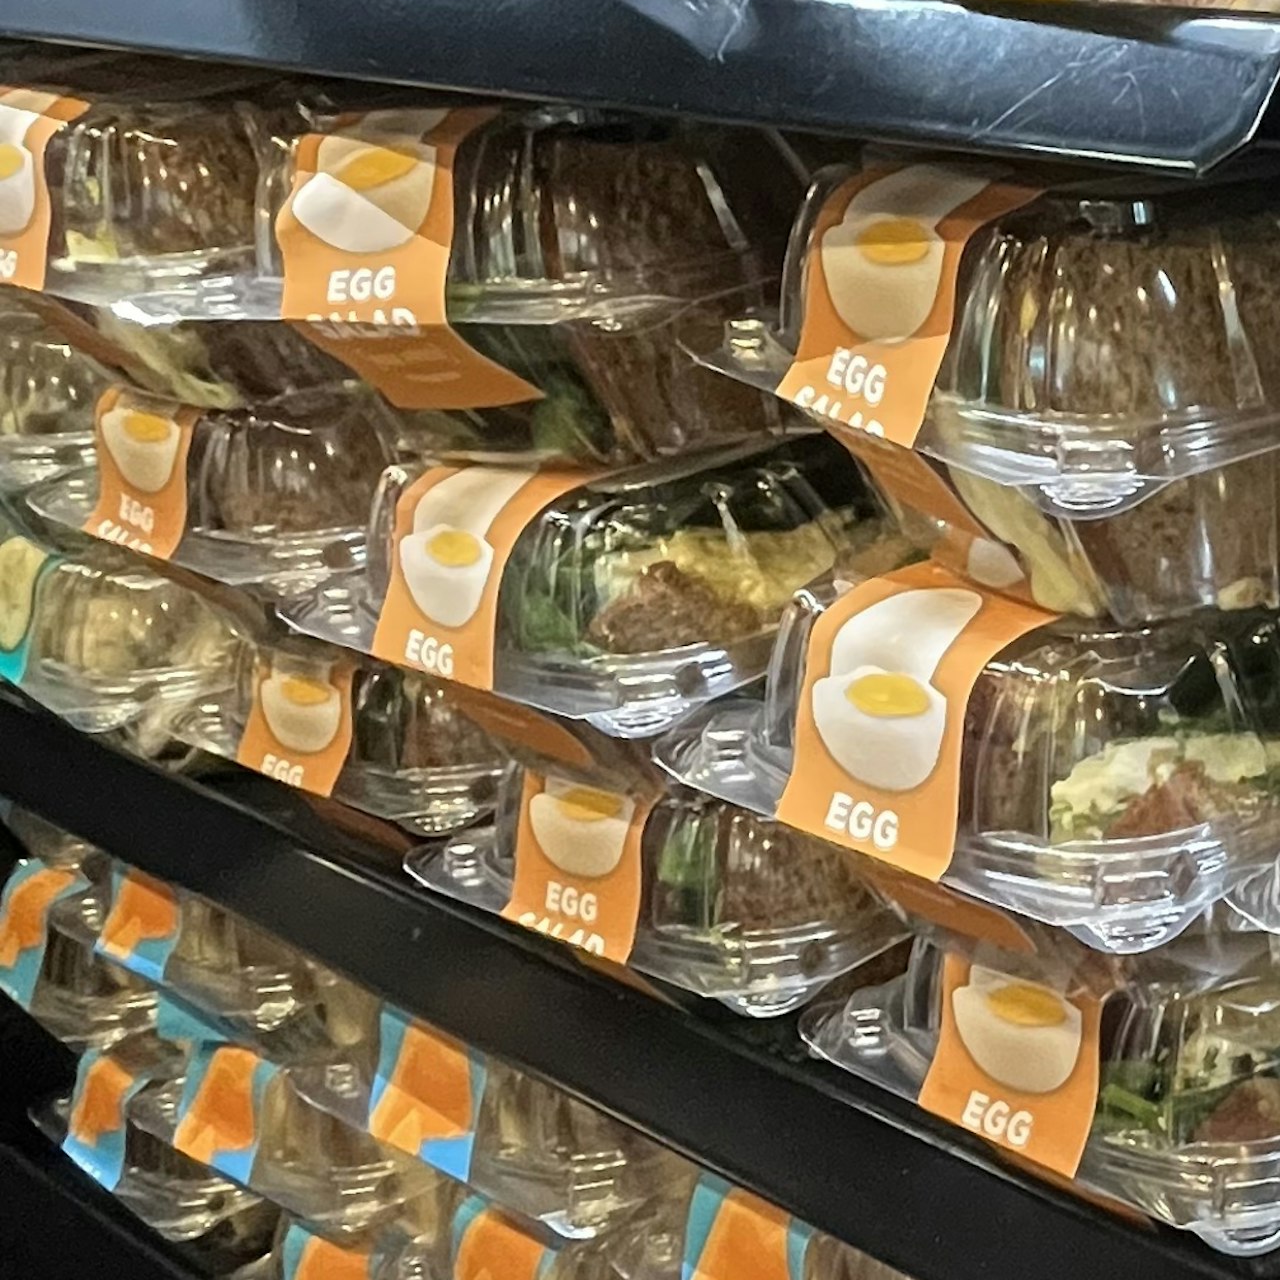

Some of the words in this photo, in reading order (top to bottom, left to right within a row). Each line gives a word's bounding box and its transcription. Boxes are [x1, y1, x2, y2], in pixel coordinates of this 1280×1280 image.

[326, 266, 397, 303] EGG
[825, 346, 888, 404] EGG
[119, 492, 155, 533] EGG
[404, 629, 456, 677] EGG
[260, 753, 305, 788] EGG
[824, 791, 900, 850] EGG
[544, 880, 598, 923] EGG
[961, 1090, 1032, 1147] EGG
